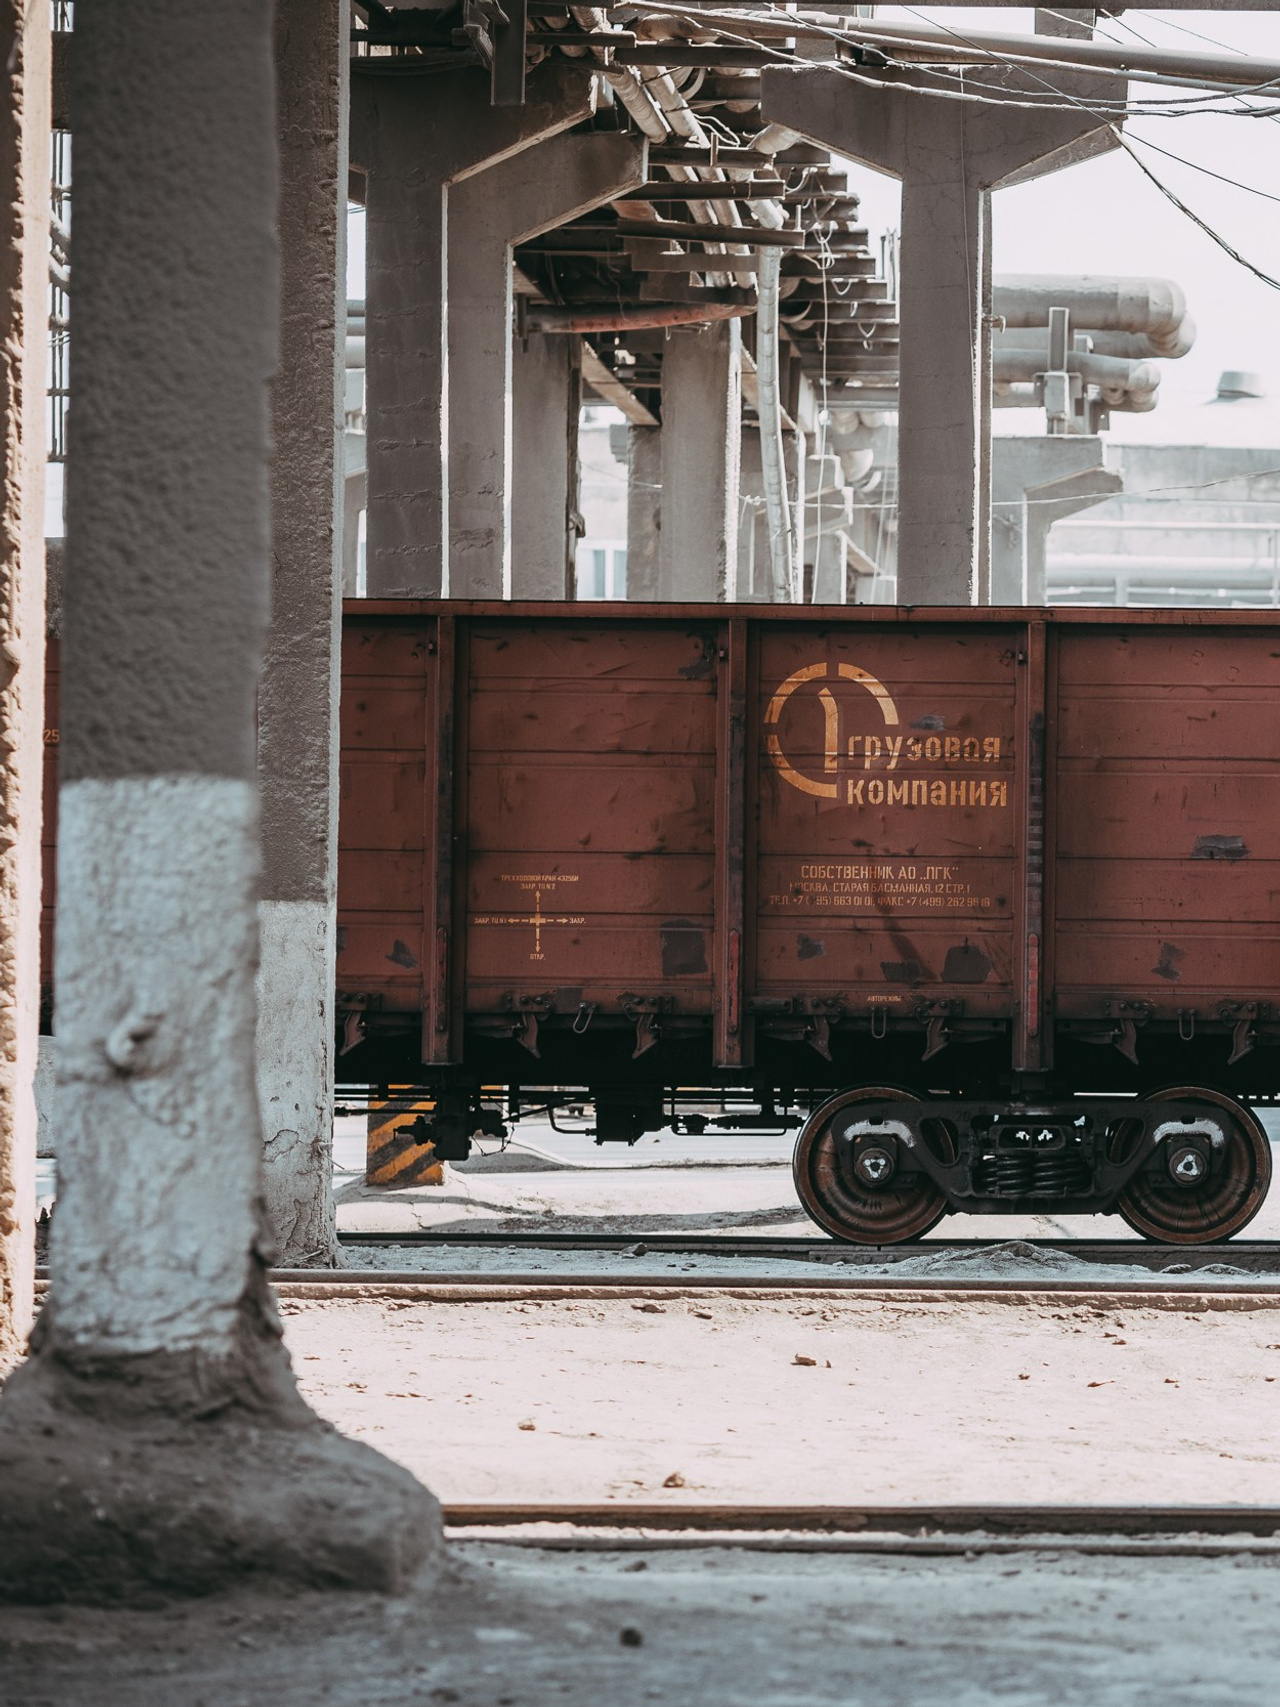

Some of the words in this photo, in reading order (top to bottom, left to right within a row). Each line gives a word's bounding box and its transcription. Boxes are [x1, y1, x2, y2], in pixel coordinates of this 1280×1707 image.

[801, 865, 895, 879] СОБСТВЕННИК
[898, 866, 916, 879] АО
[833, 882, 869, 892] СТАРАЯ
[935, 883, 944, 893] 12
[805, 896, 832, 906] (95)
[834, 896, 852, 905] 663
[877, 896, 904, 906] ФАКС
[906, 896, 917, 906] +7
[919, 896, 945, 906] (499)
[947, 897, 965, 907] 262
